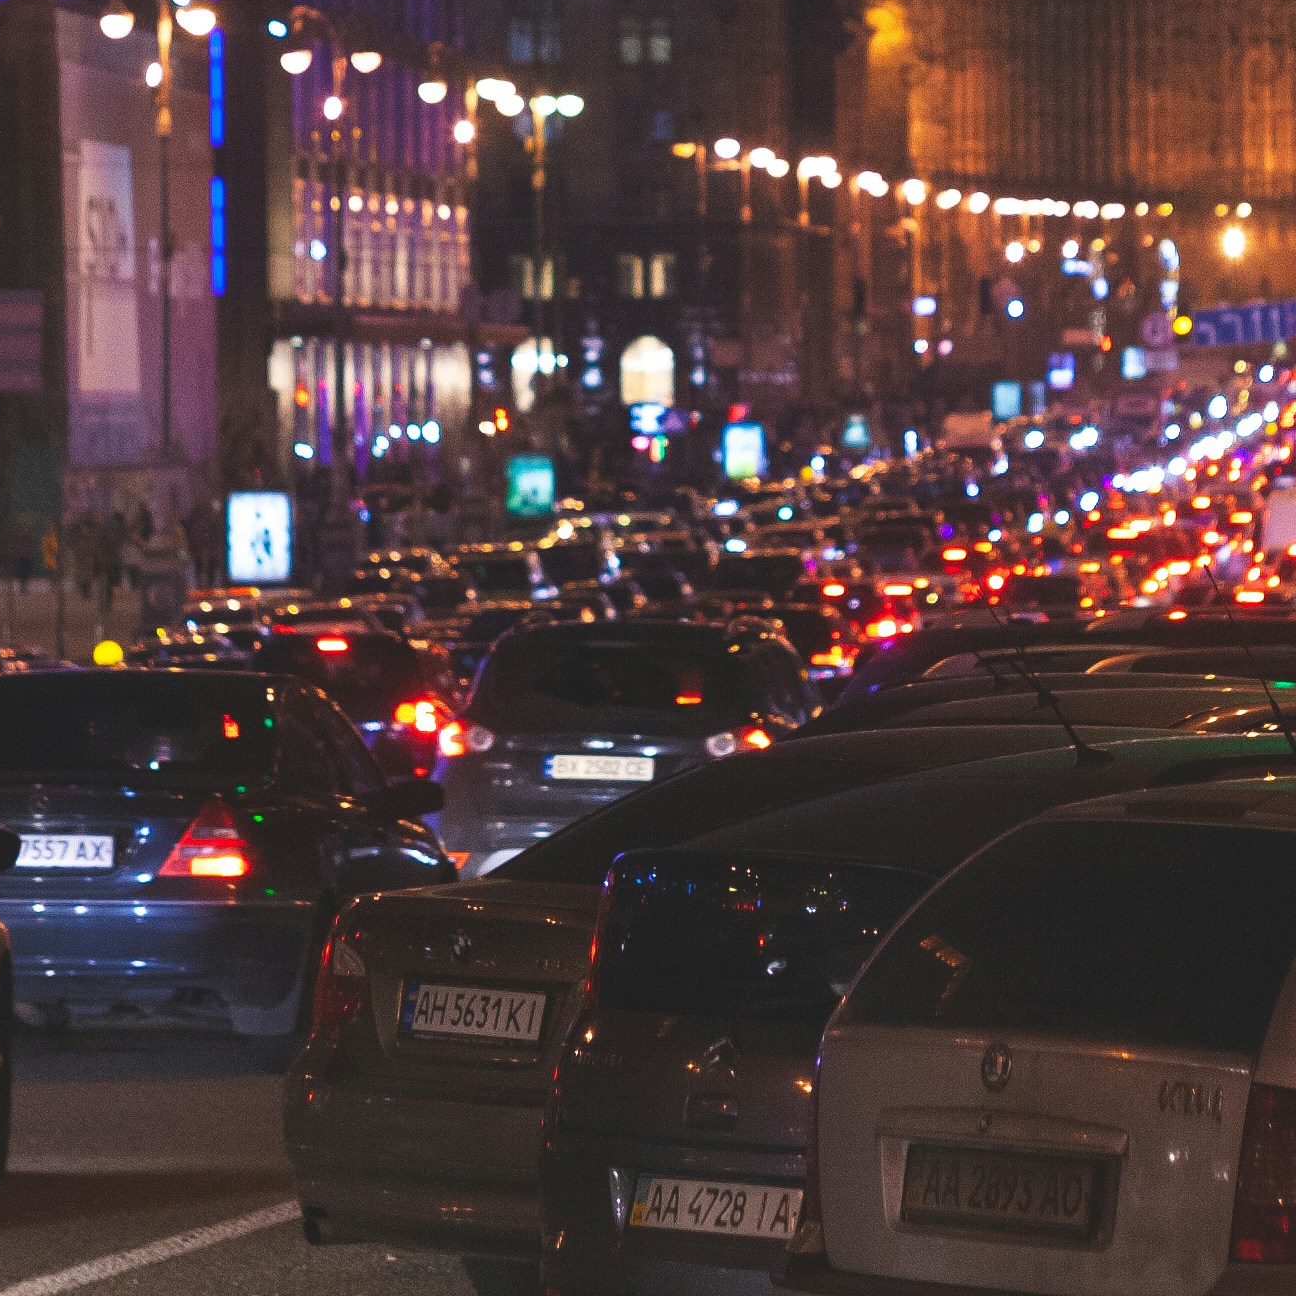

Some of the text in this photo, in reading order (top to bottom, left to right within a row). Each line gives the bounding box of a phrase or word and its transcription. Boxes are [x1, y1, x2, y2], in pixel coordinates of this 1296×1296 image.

[21, 839, 105, 860] 7557 AX
[414, 991, 538, 1034] AH 5631 KI
[646, 1184, 791, 1233] AA 4728 IA
[923, 1159, 1084, 1217] AA 2893 AO
